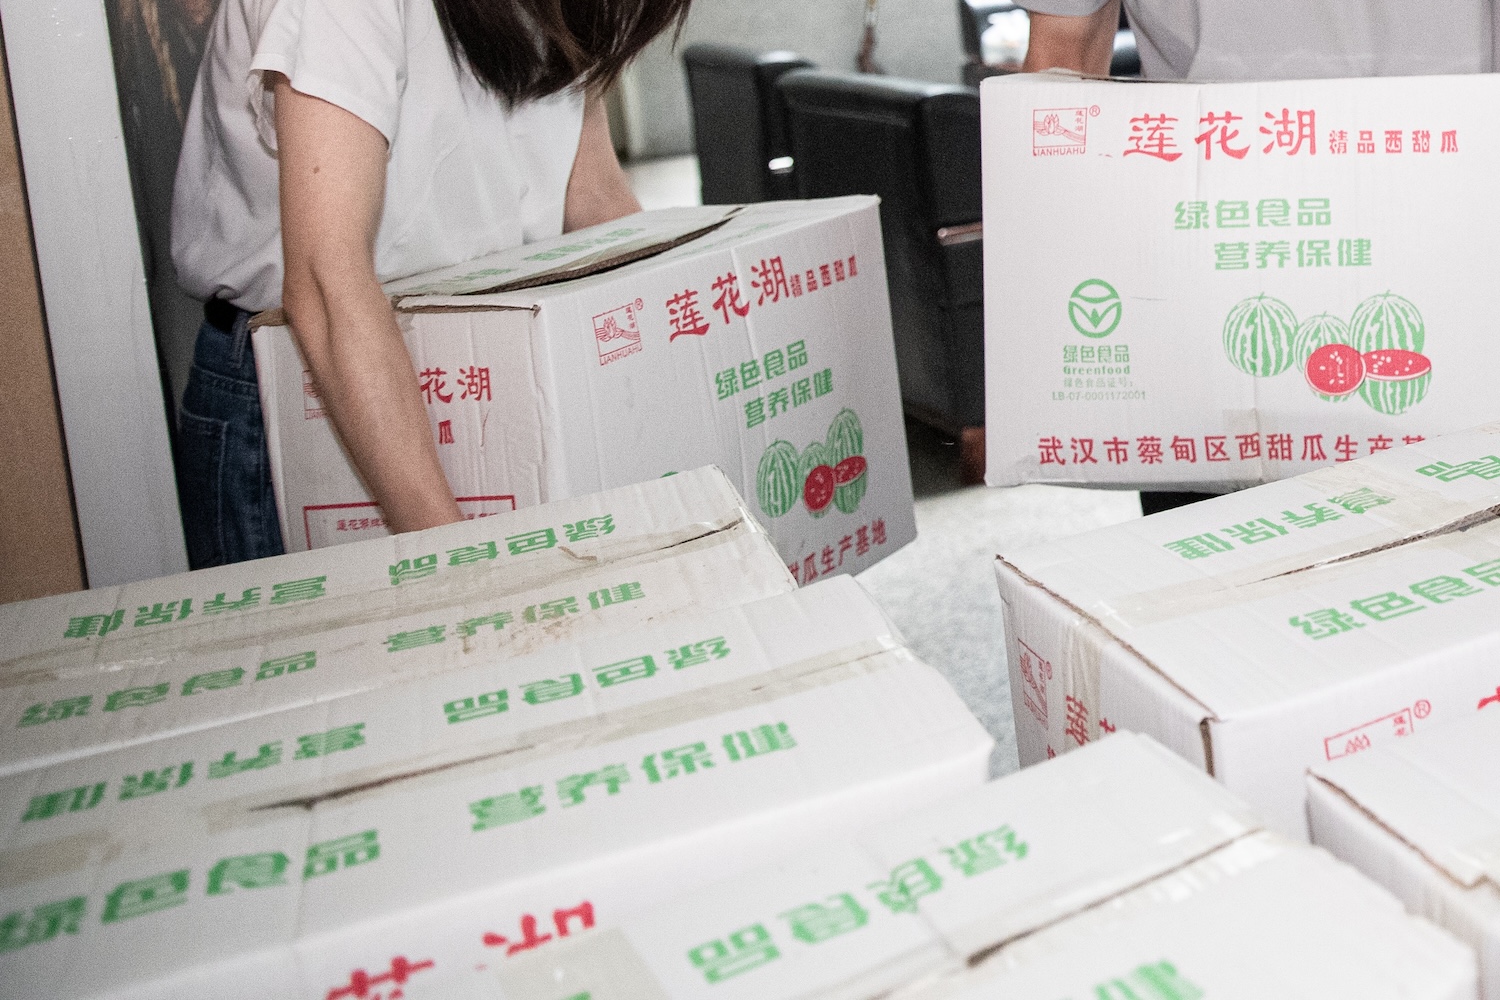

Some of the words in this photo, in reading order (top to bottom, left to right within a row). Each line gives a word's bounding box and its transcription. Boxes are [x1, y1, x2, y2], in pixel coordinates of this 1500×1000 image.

[1033, 147, 1086, 156] LIANHUAHU
[1122, 107, 1317, 163] 莲花湖
[1329, 129, 1458, 154] 精品西甜瓜
[1174, 198, 1332, 230] 绿色食品
[1214, 238, 1372, 270] 营养保健
[665, 256, 789, 343] 莲花湖
[790, 255, 858, 298] 精品西甜瓜
[419, 366, 492, 404] 花湖
[714, 339, 809, 402] 绿色食品
[1063, 344, 1130, 363] 绿色食品
[1063, 364, 1131, 375] Greenfood
[743, 367, 835, 430] 营养保健
[388, 514, 616, 586] 绿色食品
[1163, 487, 1396, 560] 营养保健
[64, 575, 327, 638] 营养保健
[20, 650, 317, 727] 绿色食品
[387, 581, 646, 653] 营养保健
[443, 636, 731, 725] 绿色食品
[20, 723, 366, 822] 营养保健
[687, 824, 1030, 986] 绿色食品
